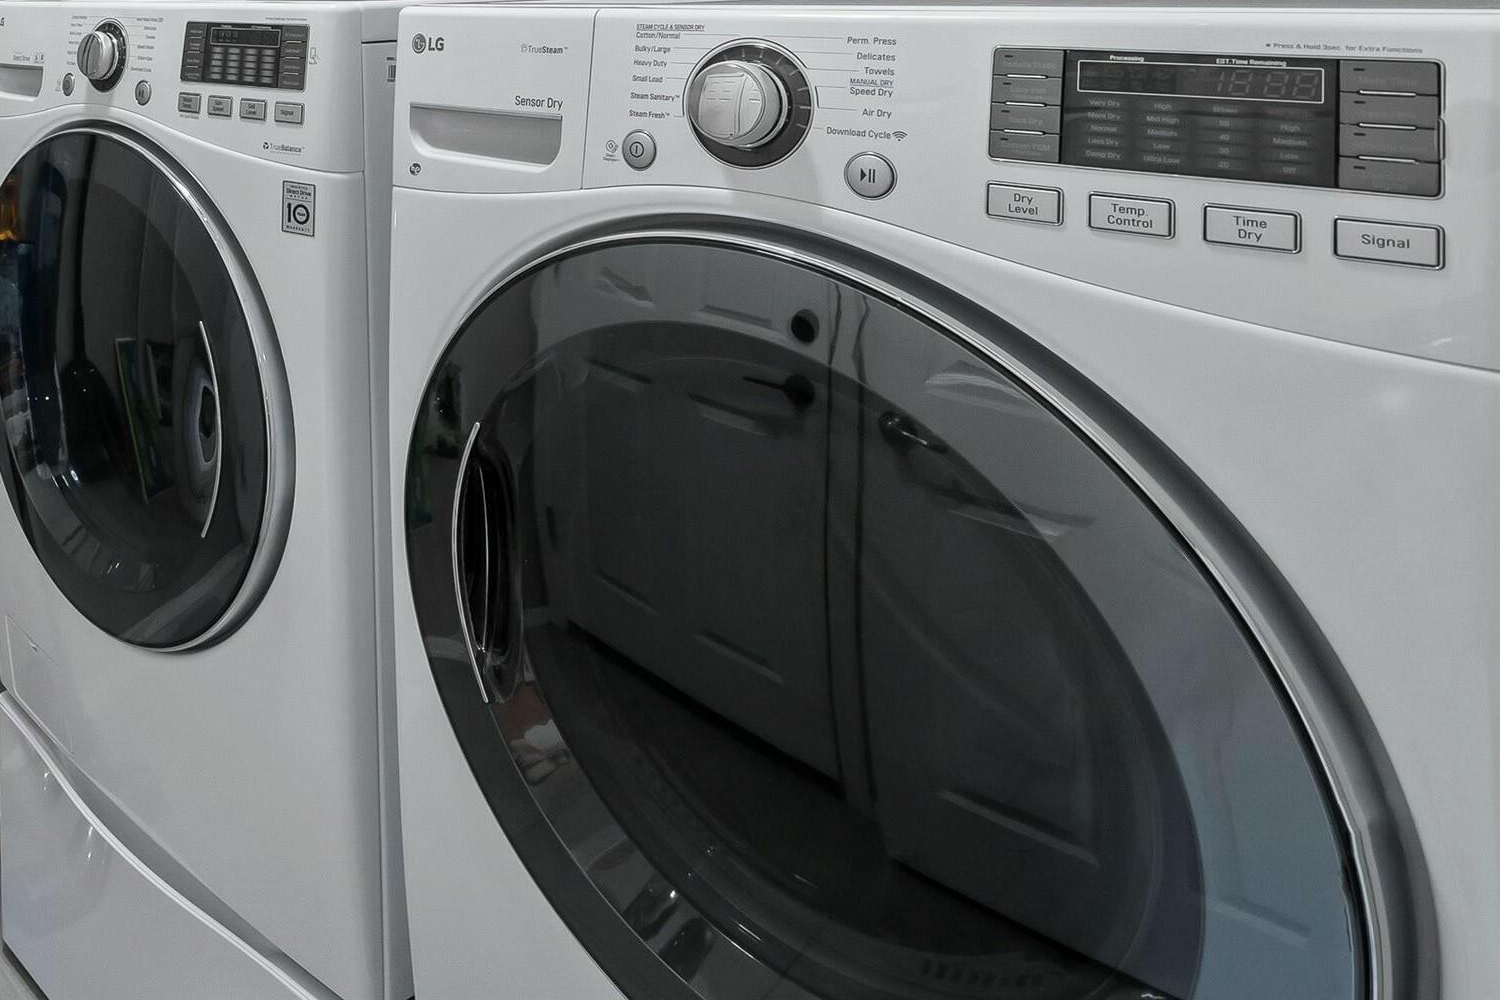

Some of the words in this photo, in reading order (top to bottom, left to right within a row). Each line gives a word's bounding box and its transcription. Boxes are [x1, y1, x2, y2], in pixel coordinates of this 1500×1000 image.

[428, 37, 445, 51] LG
[873, 37, 897, 46] Press
[634, 45, 671, 53] Bulky/Large
[856, 52, 896, 61] Delicates
[1249, 59, 1287, 67] Remaining
[864, 67, 895, 75] Towels
[648, 75, 663, 83] Load
[630, 92, 649, 100] Steam
[849, 87, 876, 96] Speed
[877, 89, 894, 98] Dry
[515, 95, 545, 107] Sensor
[547, 98, 563, 110] Dry
[629, 110, 648, 118] Steam
[862, 108, 875, 116] Air
[876, 109, 892, 119] Dry
[1107, 112, 1121, 120] Dry
[1280, 124, 1300, 132] High
[826, 127, 866, 138] Download
[868, 130, 891, 140] Cycle
[1107, 138, 1120, 146] Dry
[1273, 137, 1307, 146] Medium
[1107, 151, 1121, 160] Dry
[1280, 152, 1299, 160] Low
[1014, 193, 1034, 205] Dry
[287, 202, 310, 225] 10
[1008, 204, 1038, 215] Level
[1111, 203, 1149, 217] Temp.
[1107, 215, 1153, 228] Control
[1233, 216, 1268, 229] Time
[1238, 229, 1263, 243] Dry
[1361, 234, 1411, 249] Signal
